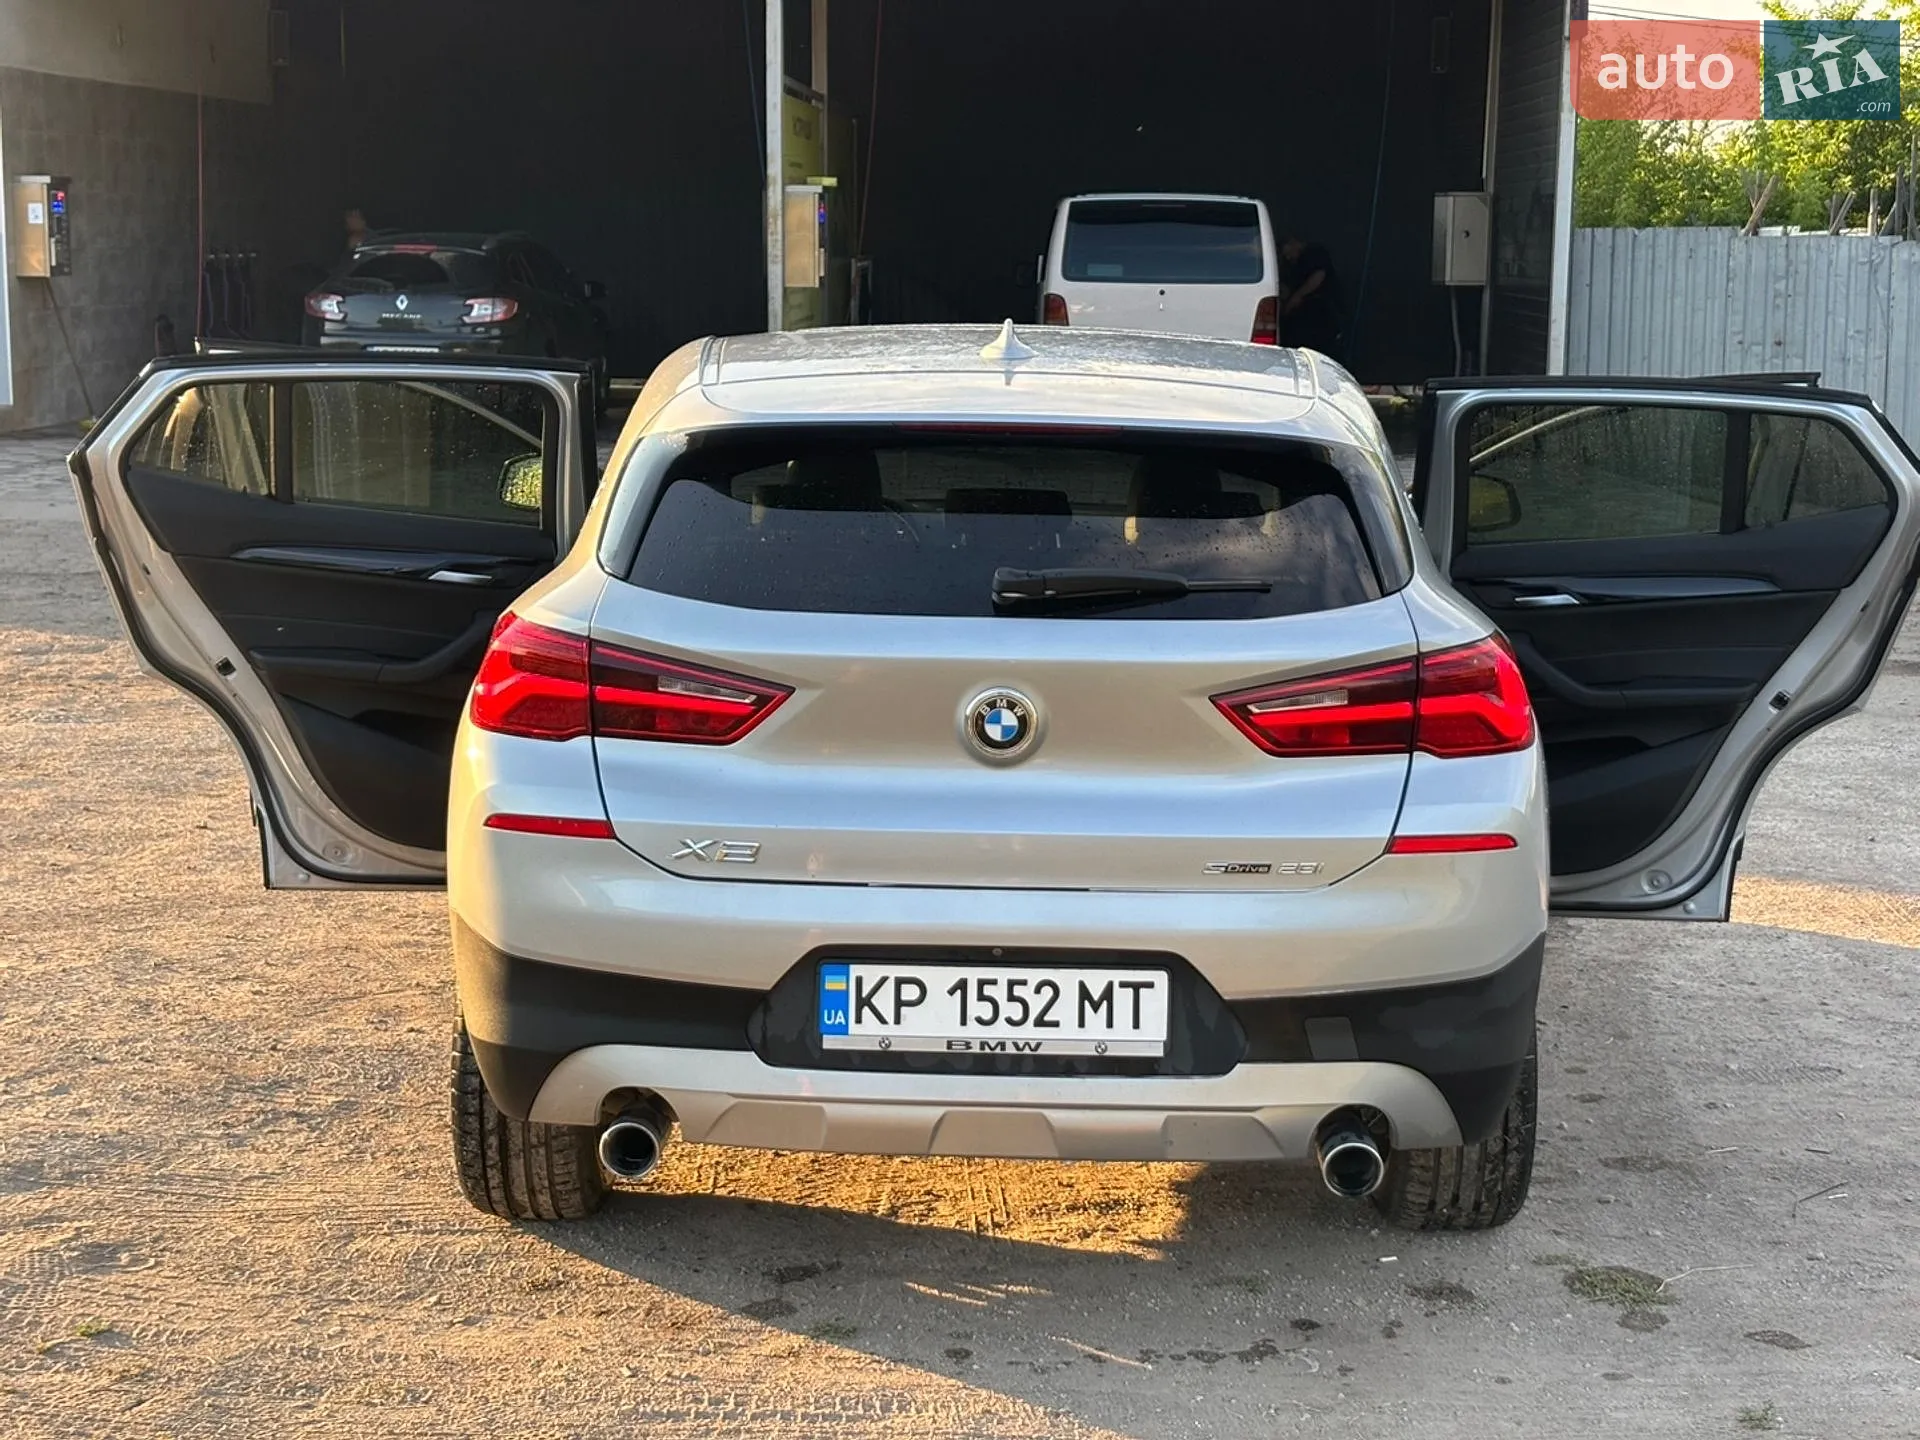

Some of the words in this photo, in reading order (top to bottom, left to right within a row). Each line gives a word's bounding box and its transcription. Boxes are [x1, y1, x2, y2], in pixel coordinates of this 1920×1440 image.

[979, 698, 1026, 716] BMW
[853, 975, 928, 1025] KP
[946, 978, 1061, 1028] 1552
[1077, 980, 1155, 1030] MT
[824, 1009, 846, 1026] UA
[945, 1039, 1044, 1053] BMW
